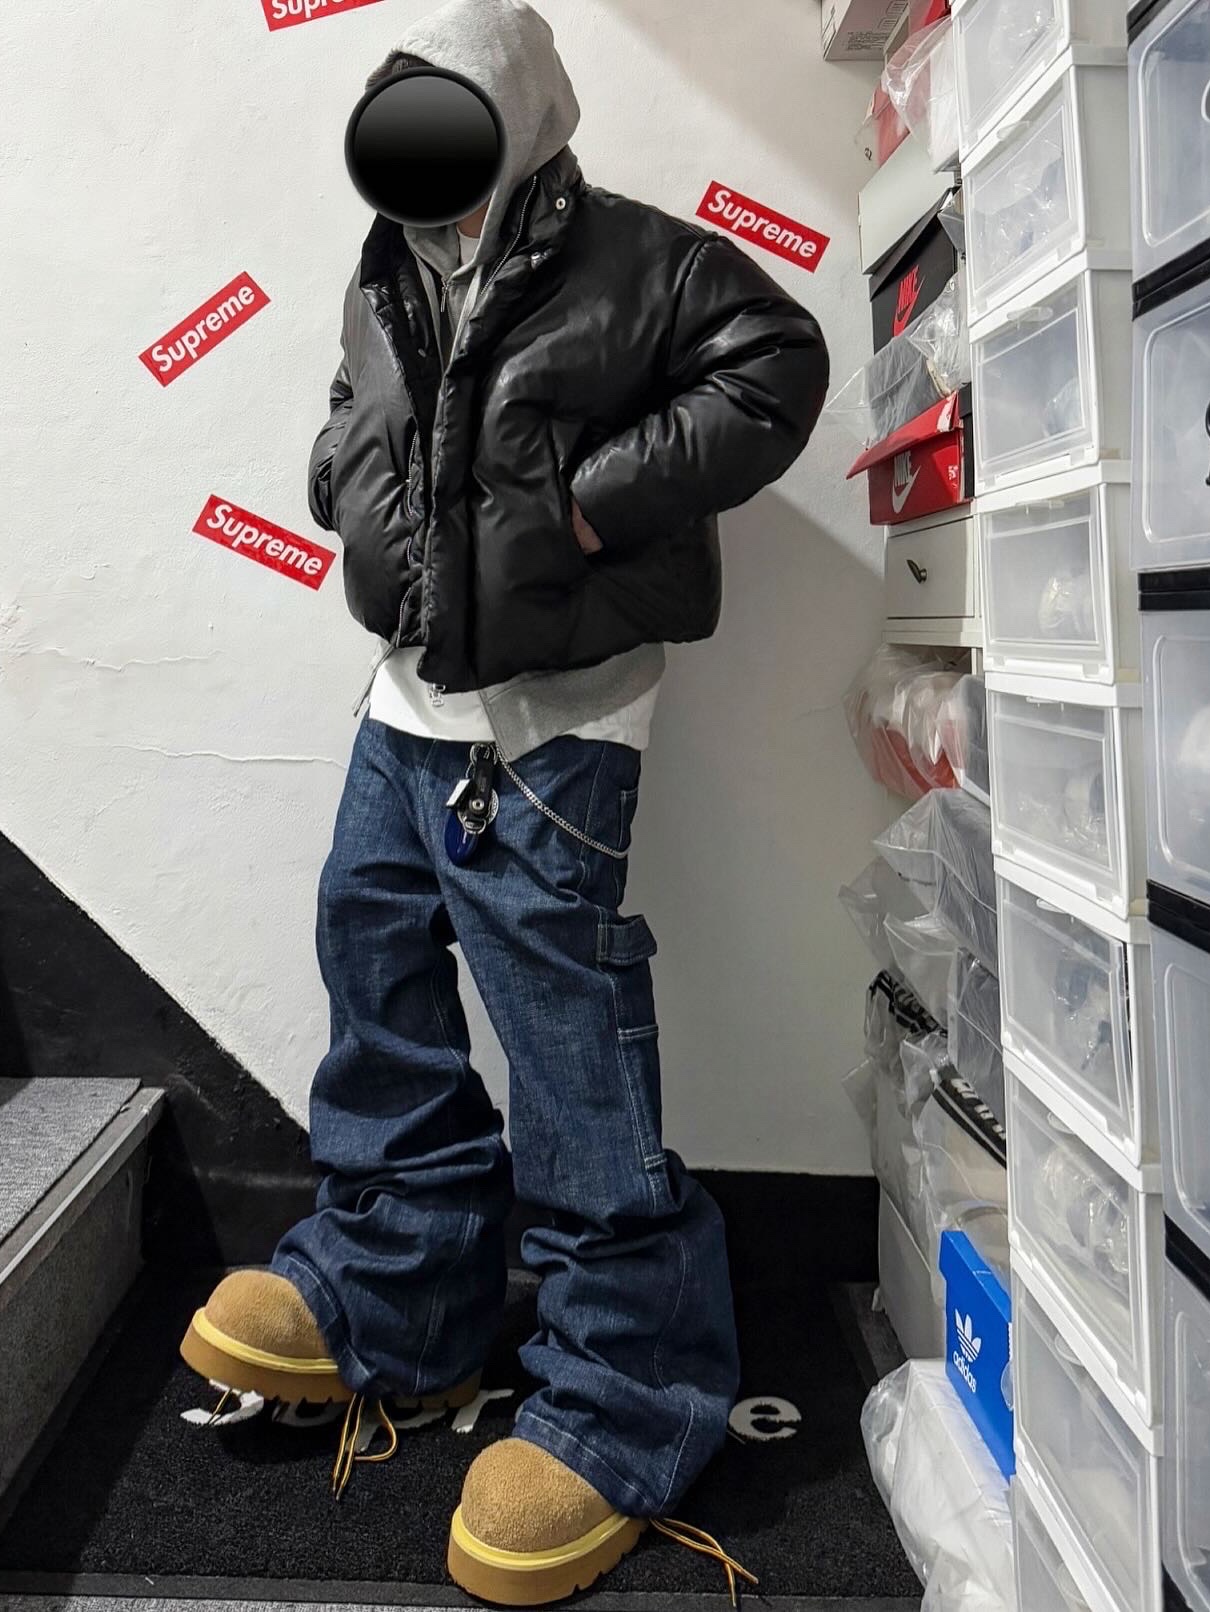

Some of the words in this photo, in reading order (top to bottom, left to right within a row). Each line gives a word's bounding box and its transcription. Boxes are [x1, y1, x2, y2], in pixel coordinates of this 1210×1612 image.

[707, 190, 817, 258] Supreme
[151, 286, 255, 372] Supreme
[206, 504, 323, 575] Supreme
[953, 1350, 977, 1393] adidas
